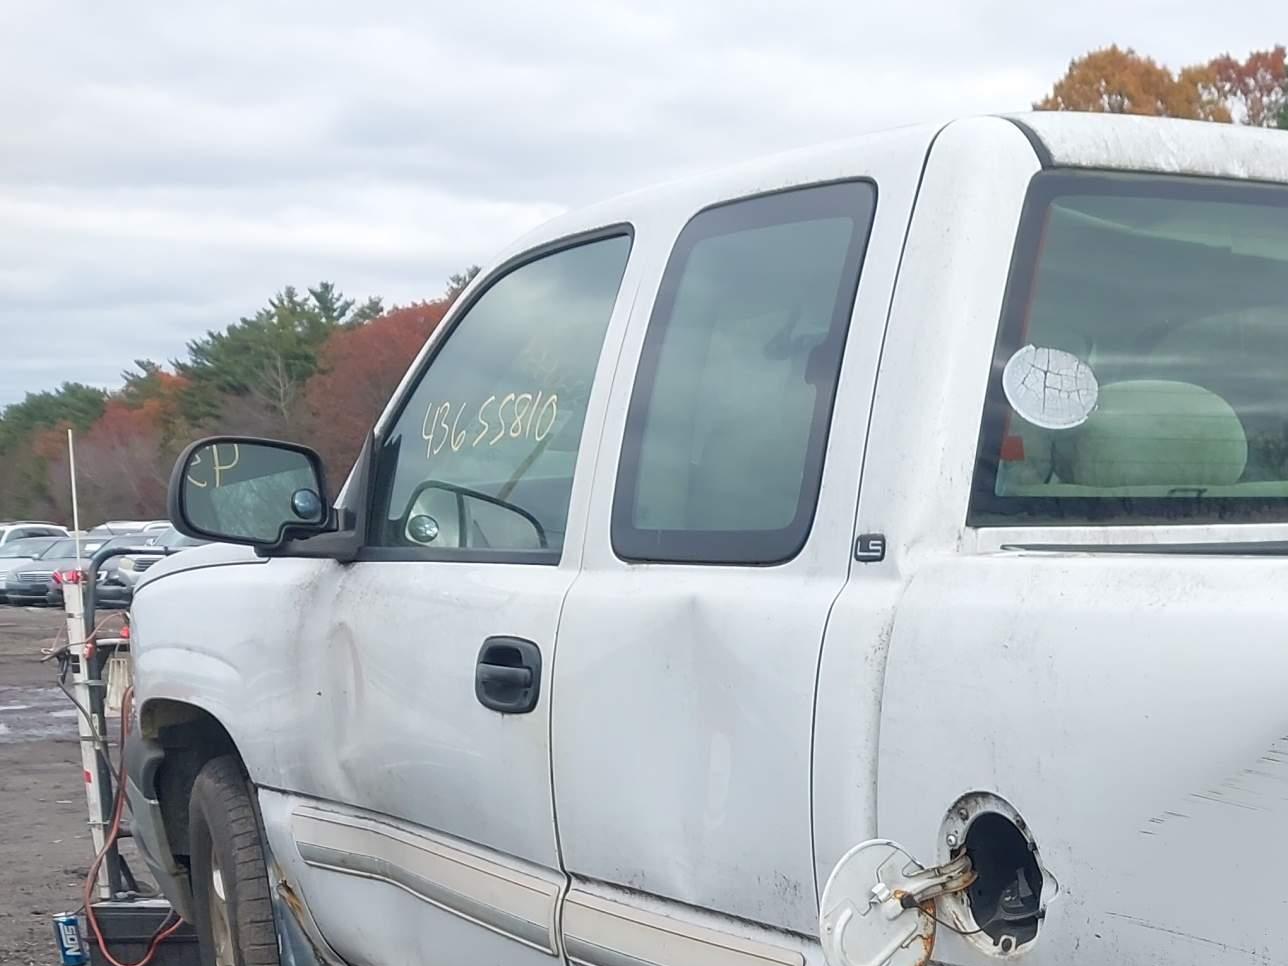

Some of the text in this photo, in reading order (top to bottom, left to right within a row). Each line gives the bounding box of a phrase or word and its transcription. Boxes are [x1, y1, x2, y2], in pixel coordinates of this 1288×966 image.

[422, 391, 557, 459] 43655810
[856, 539, 882, 556] LS
[58, 922, 82, 956] NOS
